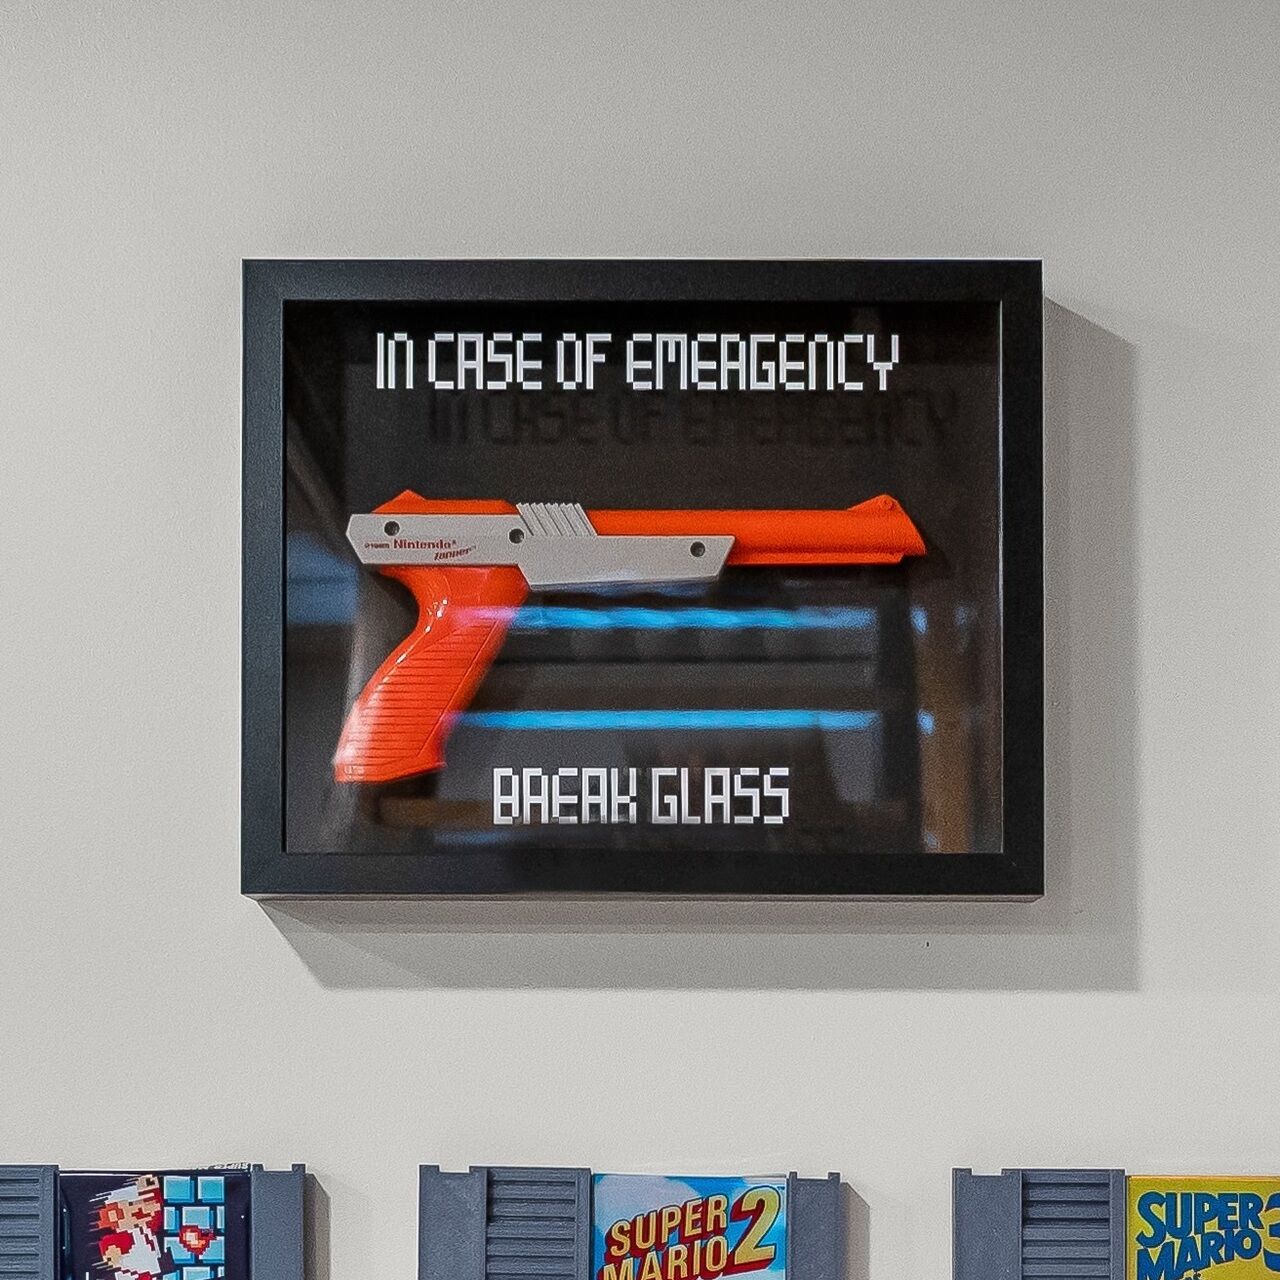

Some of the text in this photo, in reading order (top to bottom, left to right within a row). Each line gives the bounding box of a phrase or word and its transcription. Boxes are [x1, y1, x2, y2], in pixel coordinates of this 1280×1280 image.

[377, 333, 899, 390] IN CASE OF EMERGENCY
[493, 768, 789, 824] BREAK GLASS
[610, 1186, 780, 1268] SUPER 2
[1135, 1191, 1265, 1248] SUPER
